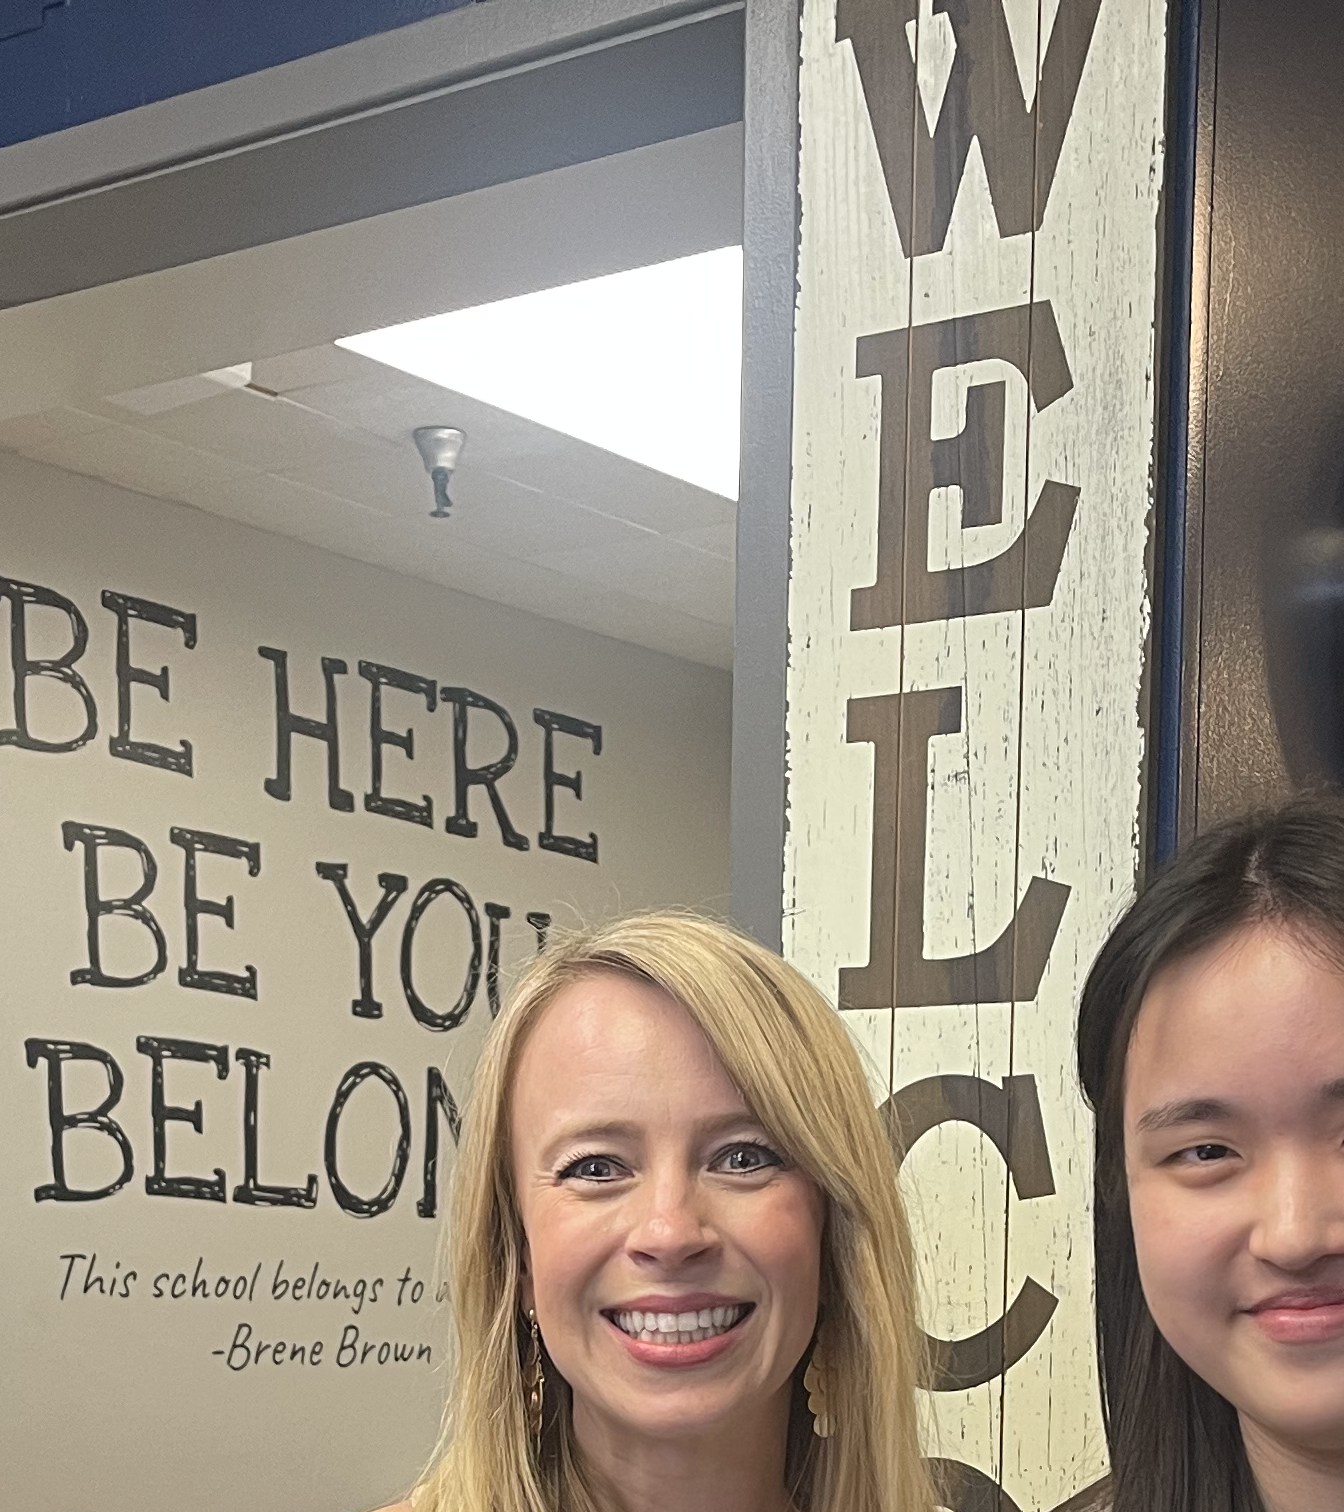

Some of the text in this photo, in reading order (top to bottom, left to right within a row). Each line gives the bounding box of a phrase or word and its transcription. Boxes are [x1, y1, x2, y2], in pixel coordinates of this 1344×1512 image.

[258, 646, 602, 863] HERE
[61, 821, 260, 1001] BE
[25, 1036, 463, 1219] BELON
[58, 1254, 136, 1302] This
[152, 1257, 262, 1304] school
[272, 1262, 384, 1314] belongs
[396, 1266, 424, 1306] to
[212, 1324, 432, 1371] -Brene Brown
